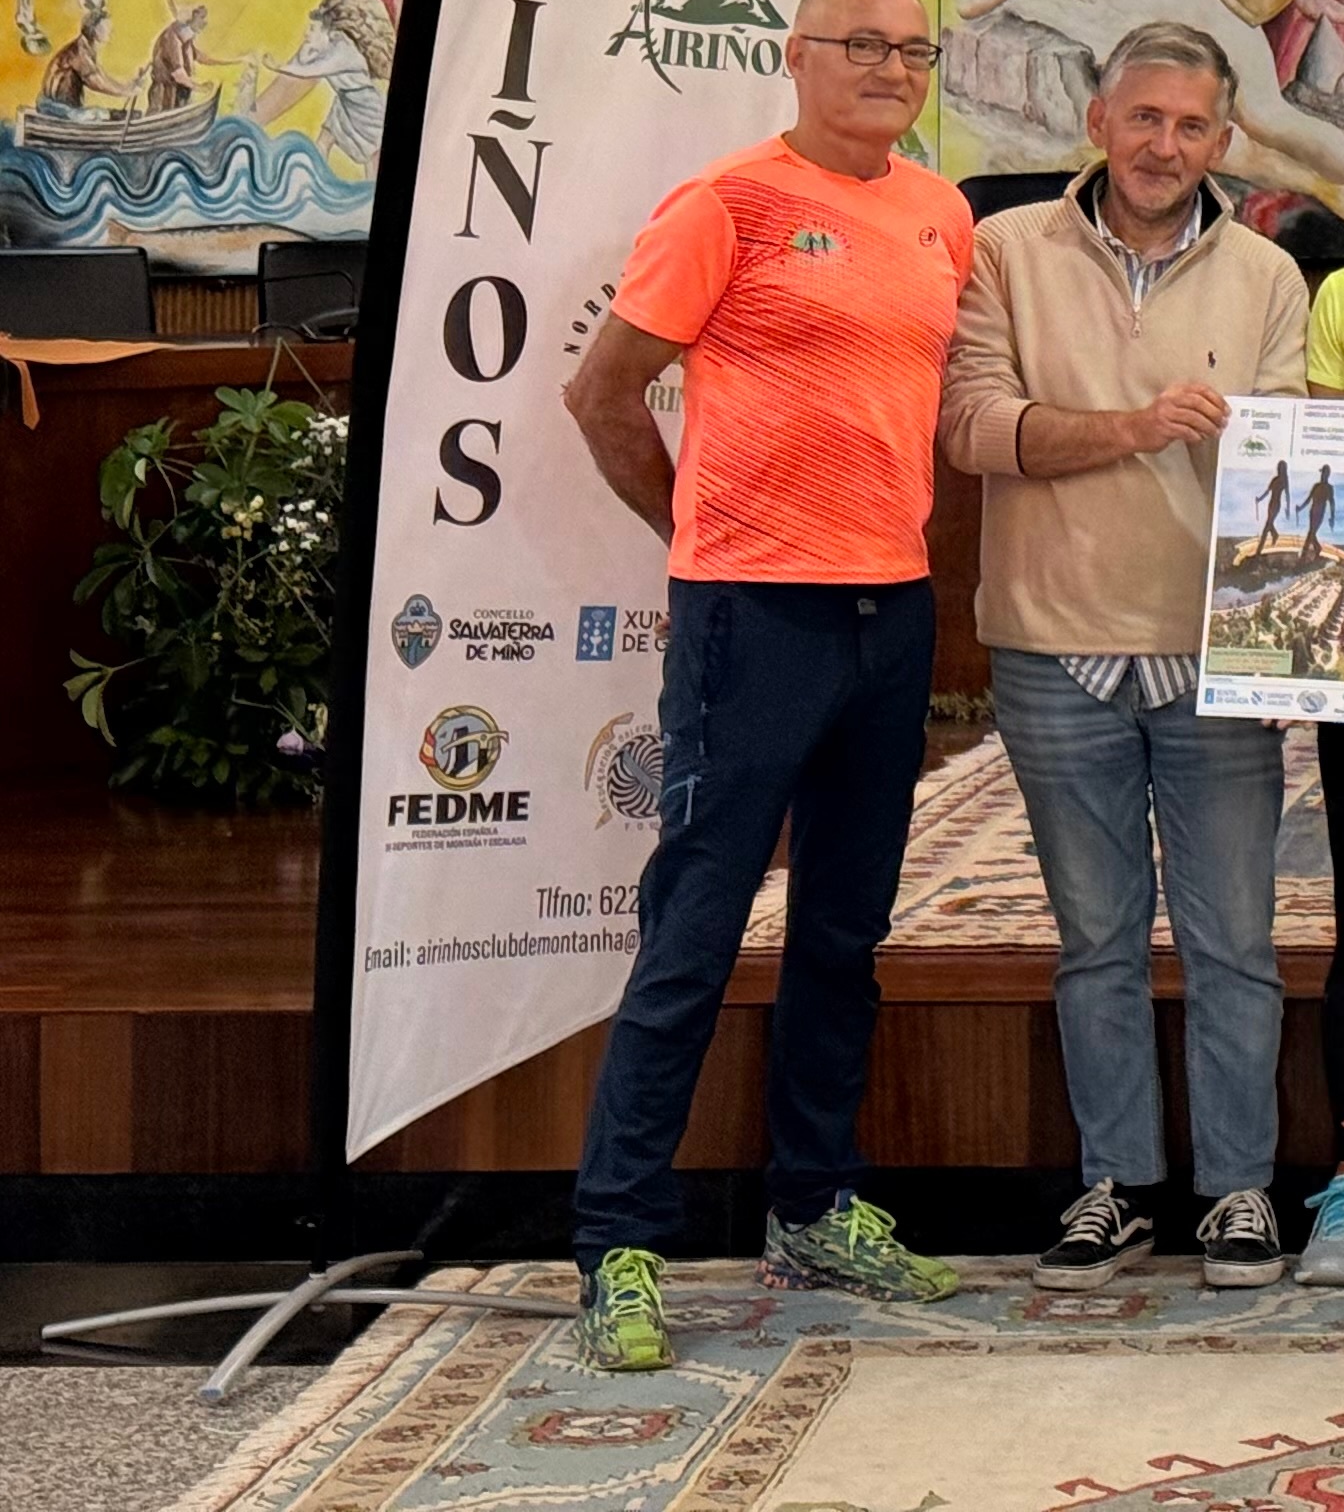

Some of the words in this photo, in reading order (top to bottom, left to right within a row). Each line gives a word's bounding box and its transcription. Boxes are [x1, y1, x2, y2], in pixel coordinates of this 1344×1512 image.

[563, 272, 626, 355] NORD
[473, 609, 534, 620] CONCELLO
[624, 610, 669, 630] XUN
[449, 619, 554, 641] SALVATERRA
[466, 644, 488, 660] DE
[492, 641, 535, 662] MIÑO
[622, 634, 650, 653] DE
[388, 791, 530, 826] FEDME
[537, 887, 592, 919] Tlfno:
[416, 926, 640, 966] airinhosclubdemontanha@
